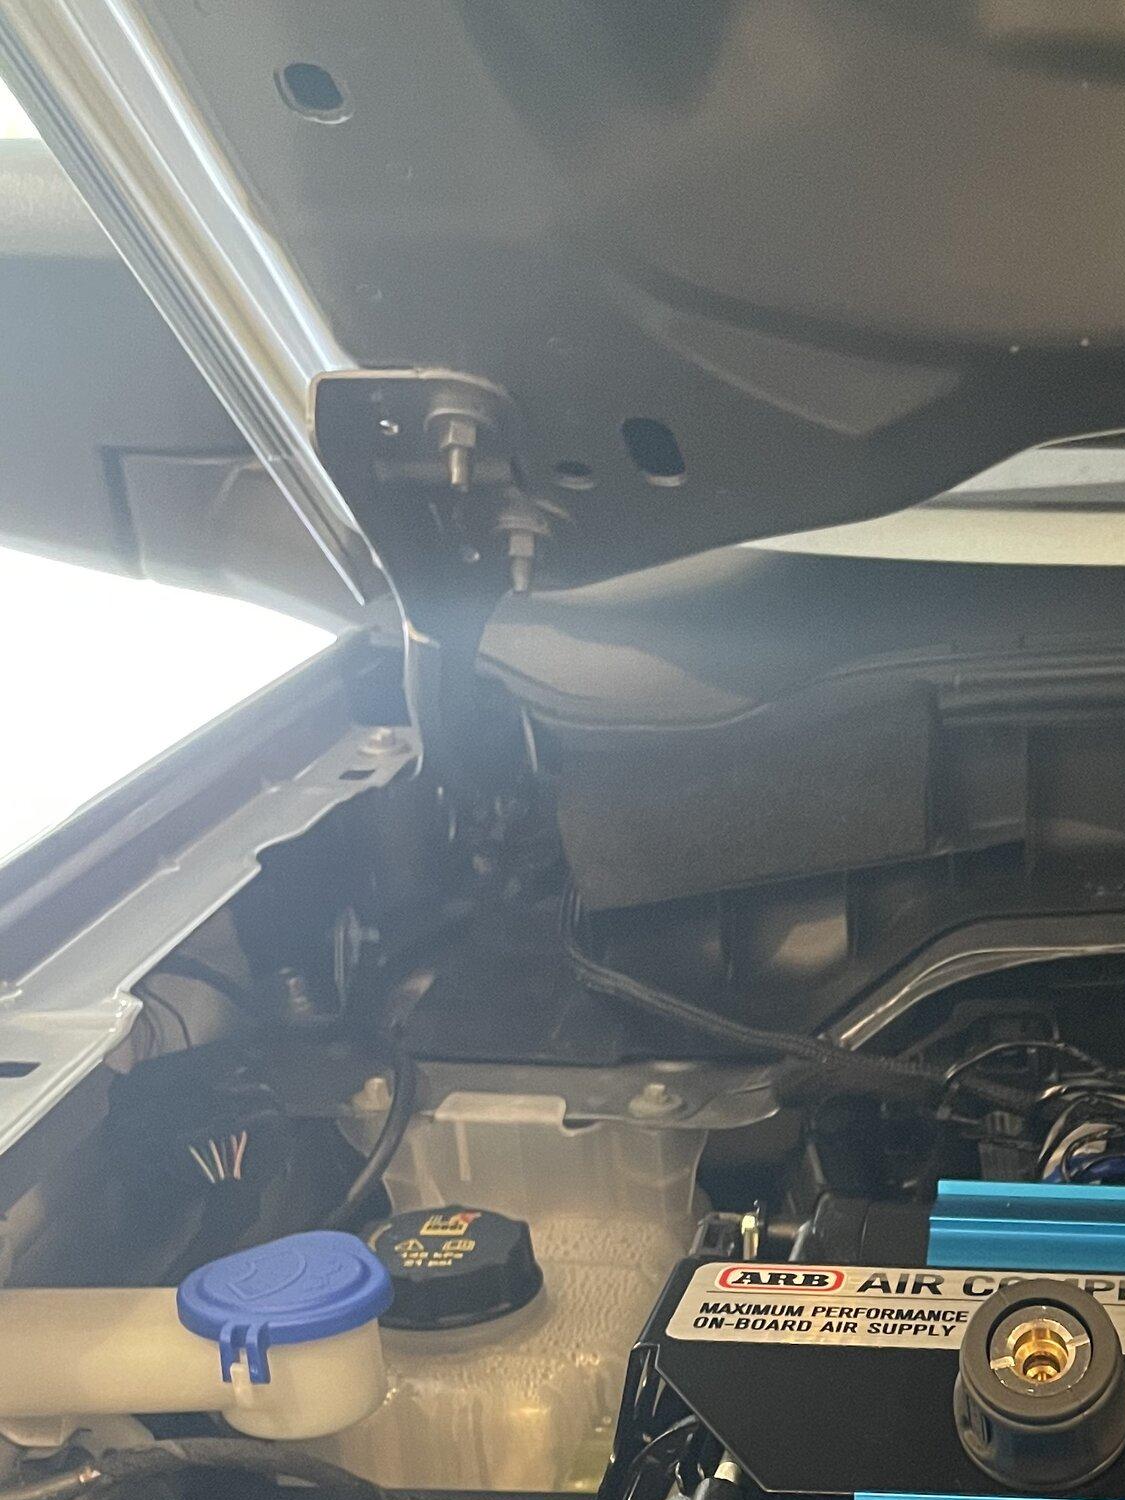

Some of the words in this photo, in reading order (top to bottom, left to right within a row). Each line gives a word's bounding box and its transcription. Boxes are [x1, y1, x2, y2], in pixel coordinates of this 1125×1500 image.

[728, 1270, 835, 1289] ARB
[857, 1273, 944, 1296] AIR
[700, 1302, 805, 1317] MAXIMUM
[812, 1306, 970, 1323] PERFORMANCE
[693, 1316, 812, 1333] ON-BOARD
[824, 1321, 858, 1334] AIR
[867, 1323, 956, 1337] SUPPLY
